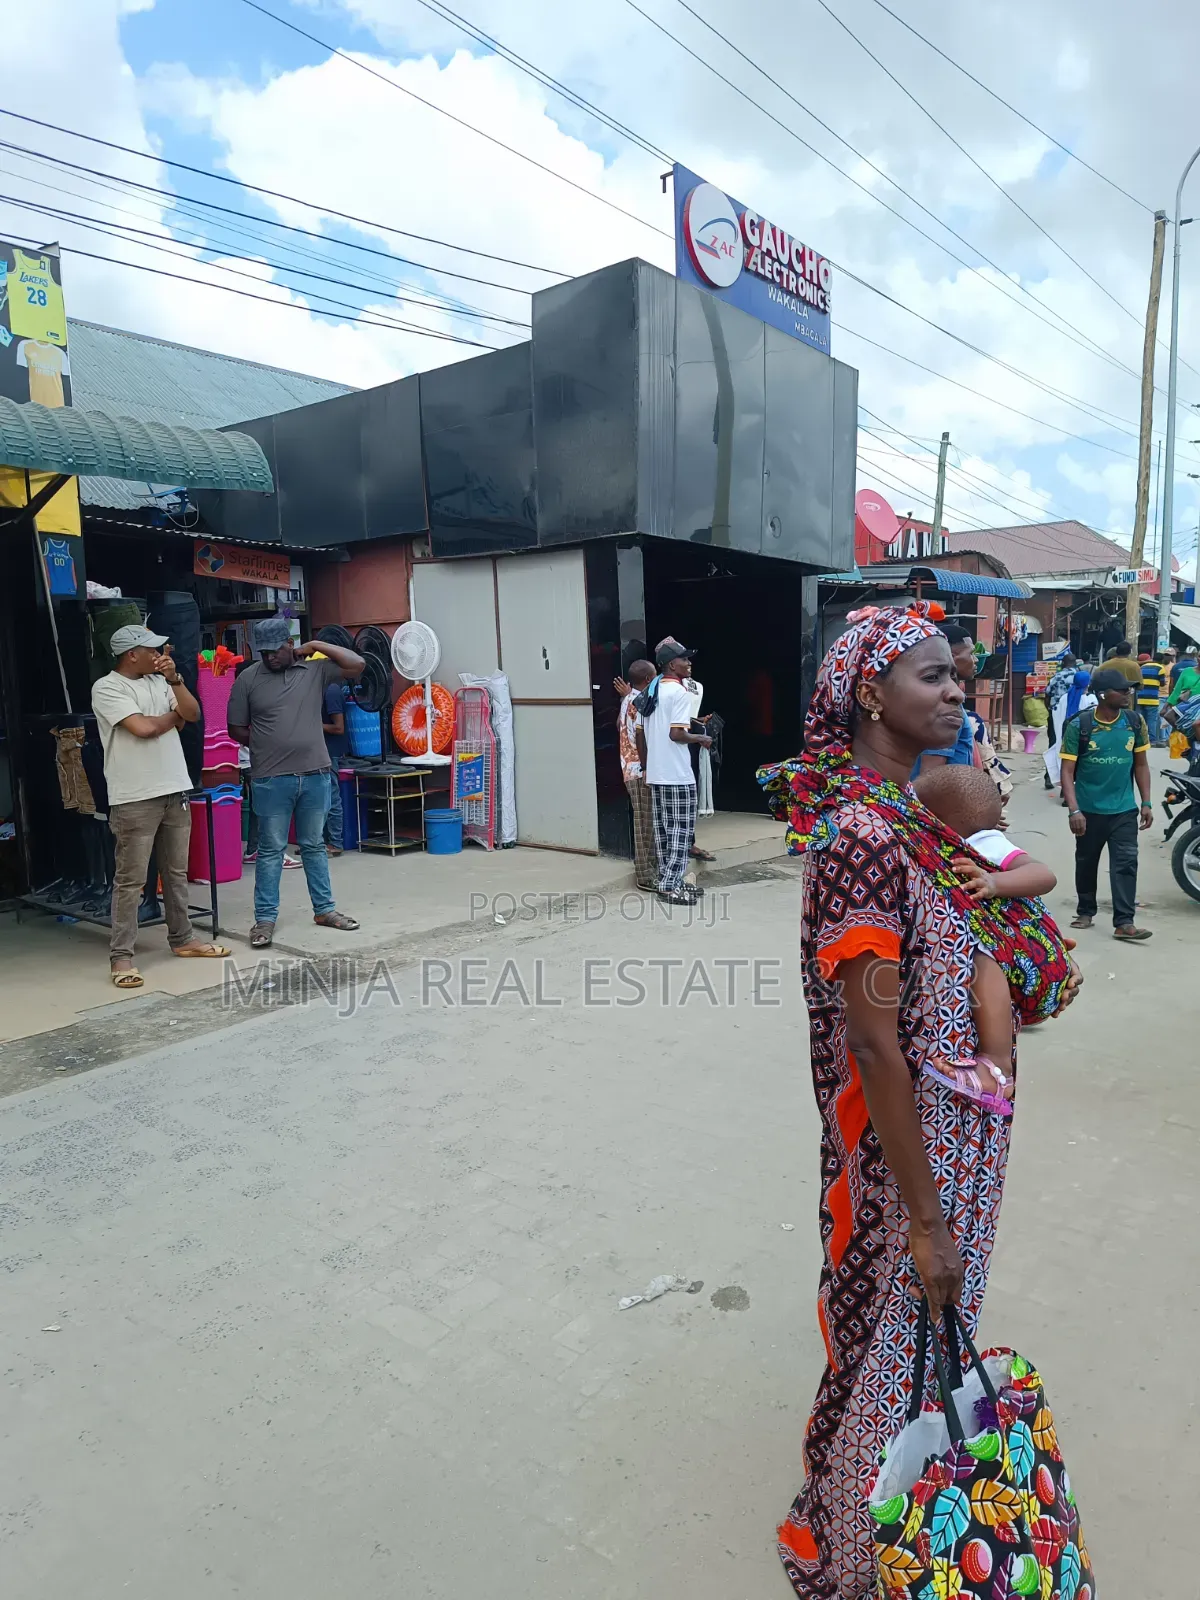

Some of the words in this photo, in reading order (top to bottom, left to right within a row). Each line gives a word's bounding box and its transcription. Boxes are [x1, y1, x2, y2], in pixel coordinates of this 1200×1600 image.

[710, 234, 736, 258] ZAC
[740, 208, 833, 293] GAUCHO
[745, 246, 832, 314] ELECTRONICS
[27, 286, 47, 307] 28
[767, 283, 809, 320] WAKALA
[228, 551, 290, 573] StarTimes
[241, 567, 280, 581] WAKALA
[1119, 571, 1136, 583] FUNDI
[1138, 570, 1154, 581] SIMU
